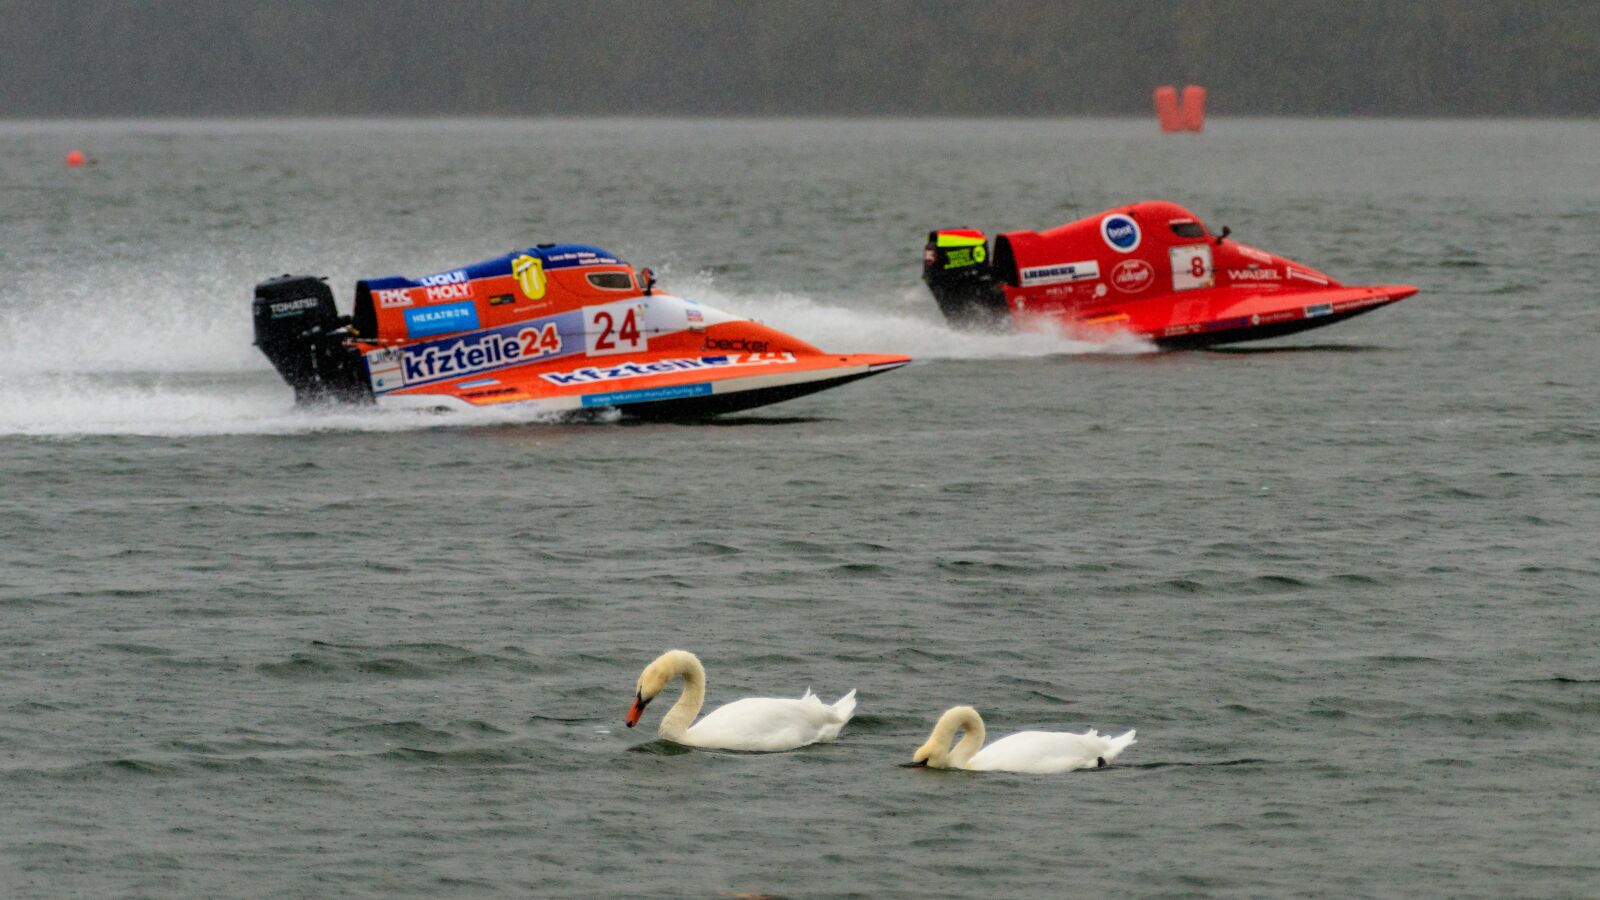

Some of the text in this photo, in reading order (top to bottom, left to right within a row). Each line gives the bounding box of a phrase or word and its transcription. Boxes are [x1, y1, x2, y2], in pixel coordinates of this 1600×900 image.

[1191, 256, 1204, 278] 8
[421, 271, 466, 287] LIQUI
[379, 288, 412, 305] FMC
[426, 283, 470, 300] MOLY
[593, 308, 640, 350] 24
[403, 323, 560, 381] kfzteile24
[705, 336, 769, 354] becker
